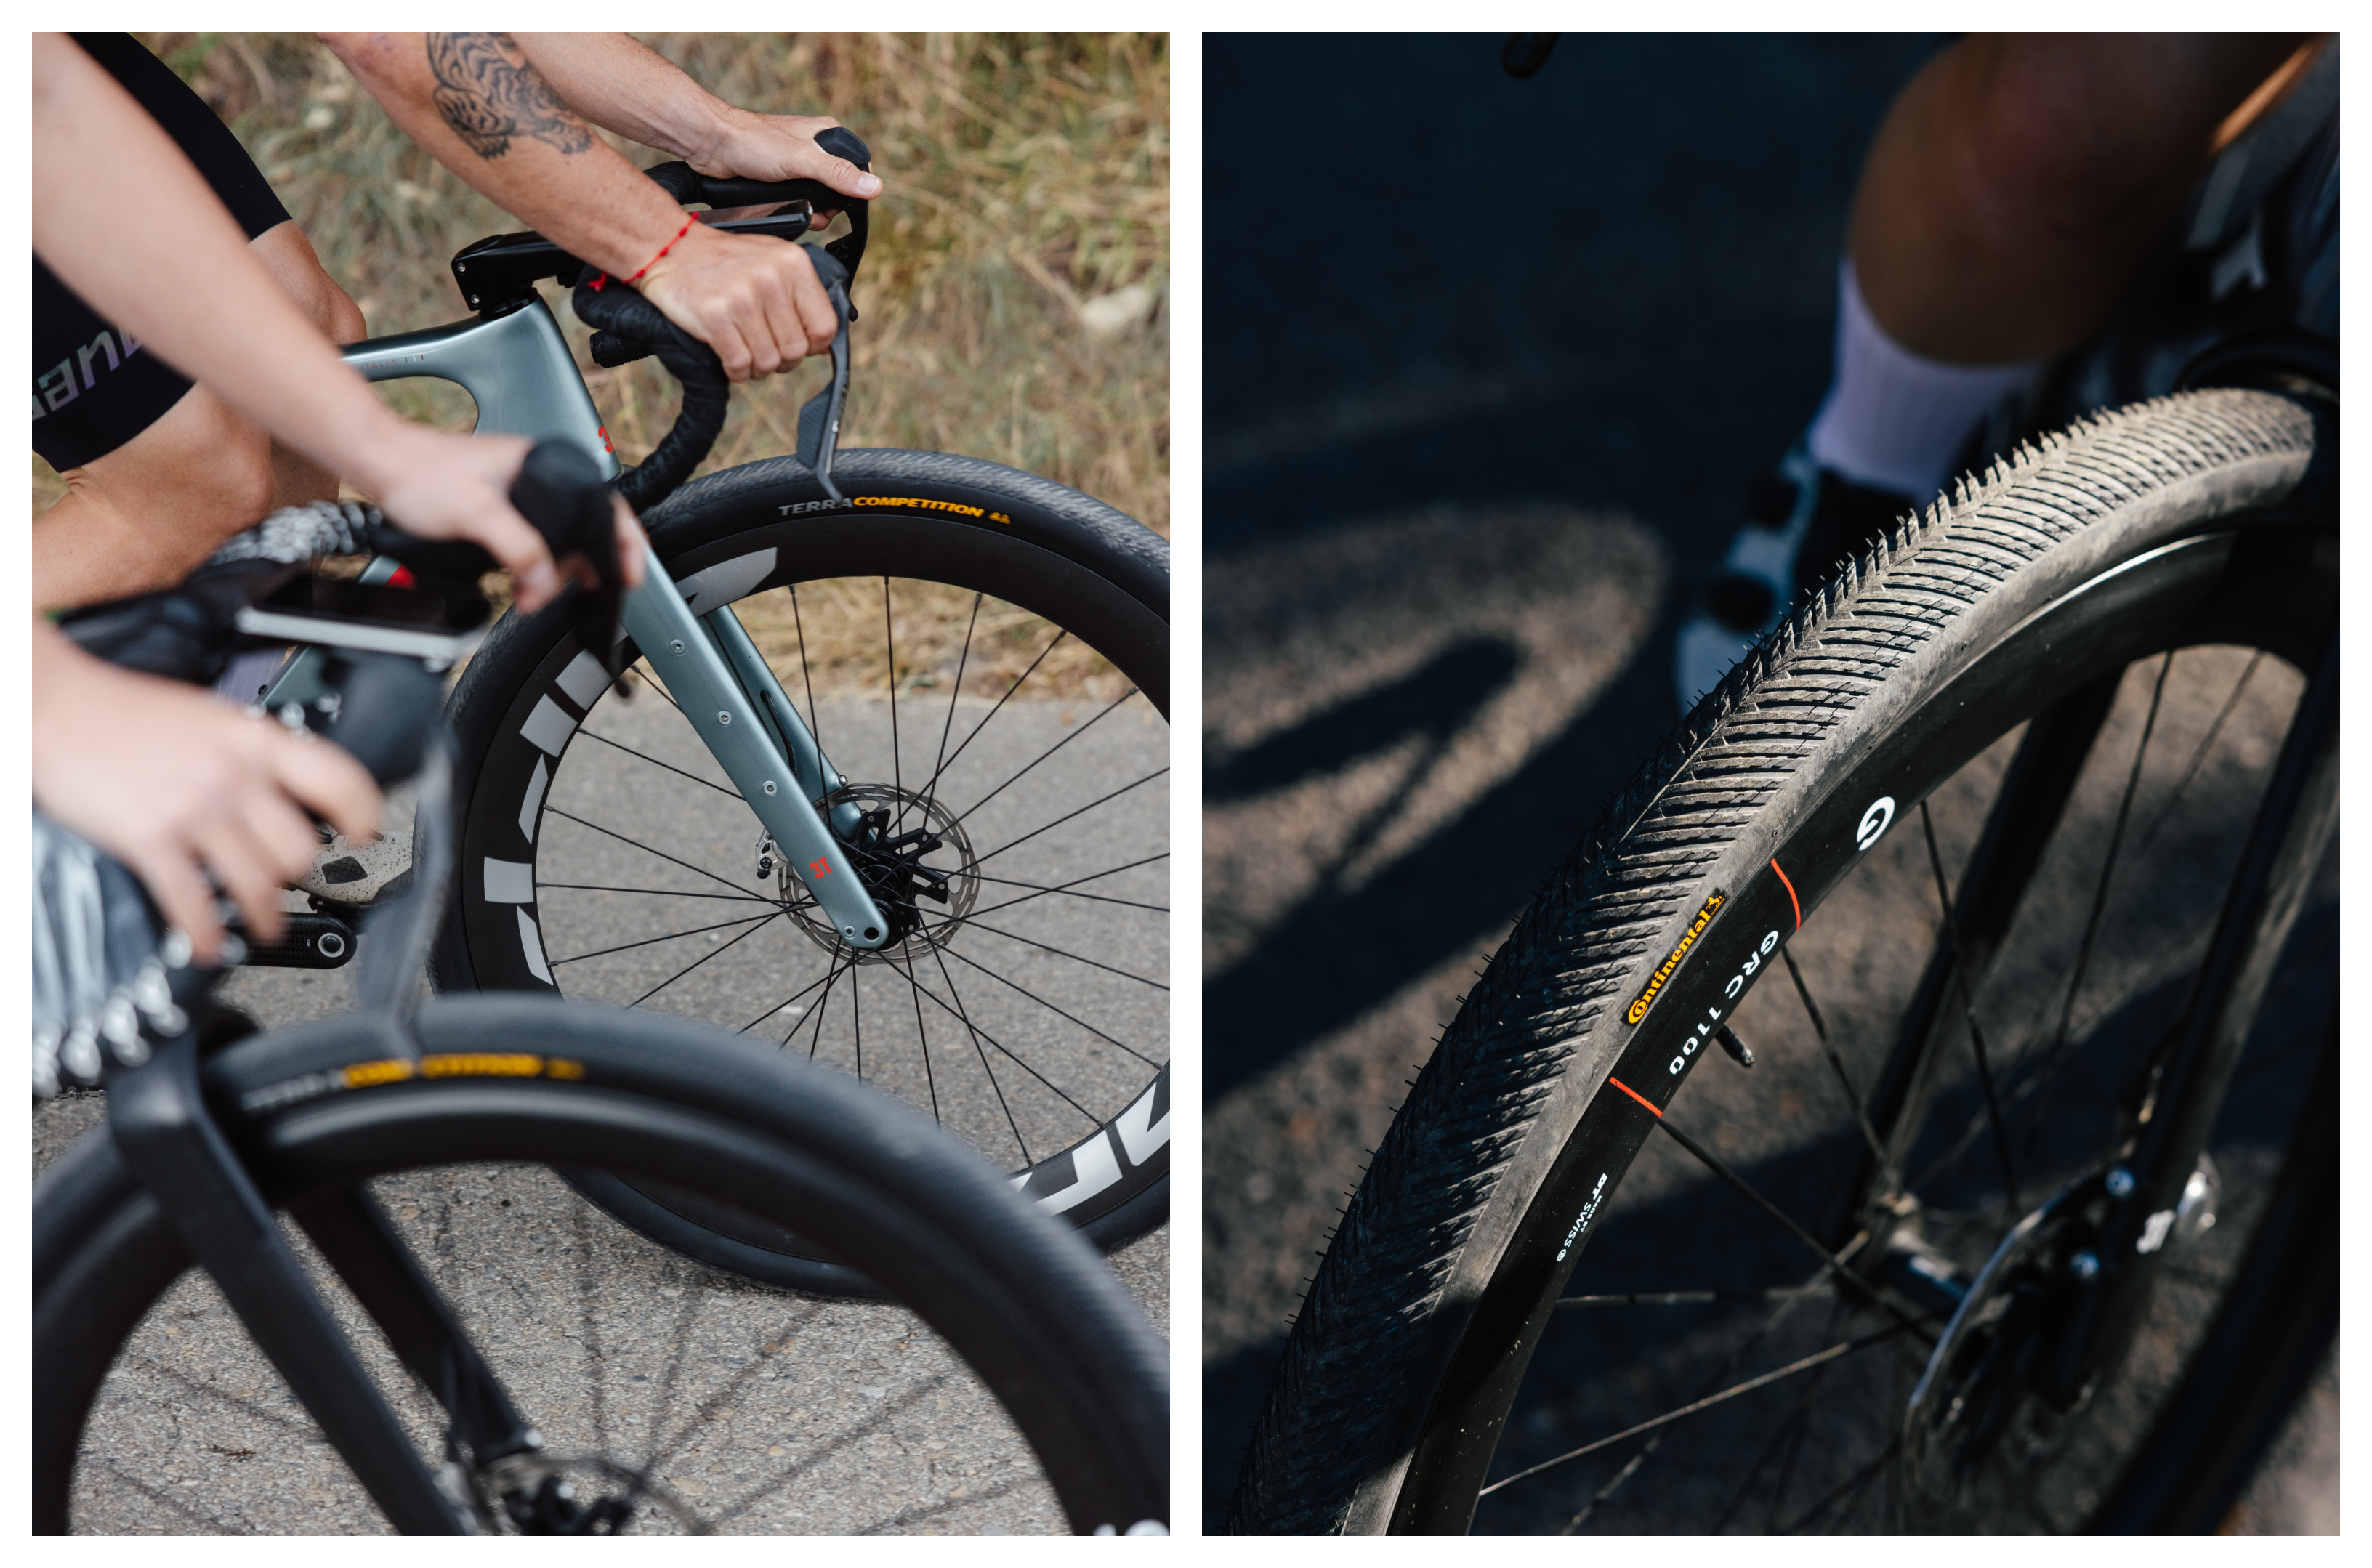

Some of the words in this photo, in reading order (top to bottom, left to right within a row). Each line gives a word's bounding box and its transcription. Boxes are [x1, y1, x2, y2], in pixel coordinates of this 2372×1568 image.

[360, 359, 398, 371] ITALIA
[808, 856, 833, 879] 3T
[1628, 908, 1715, 1025] Continental
[1724, 930, 1779, 1000] GRC
[1669, 1006, 1722, 1075] 1100
